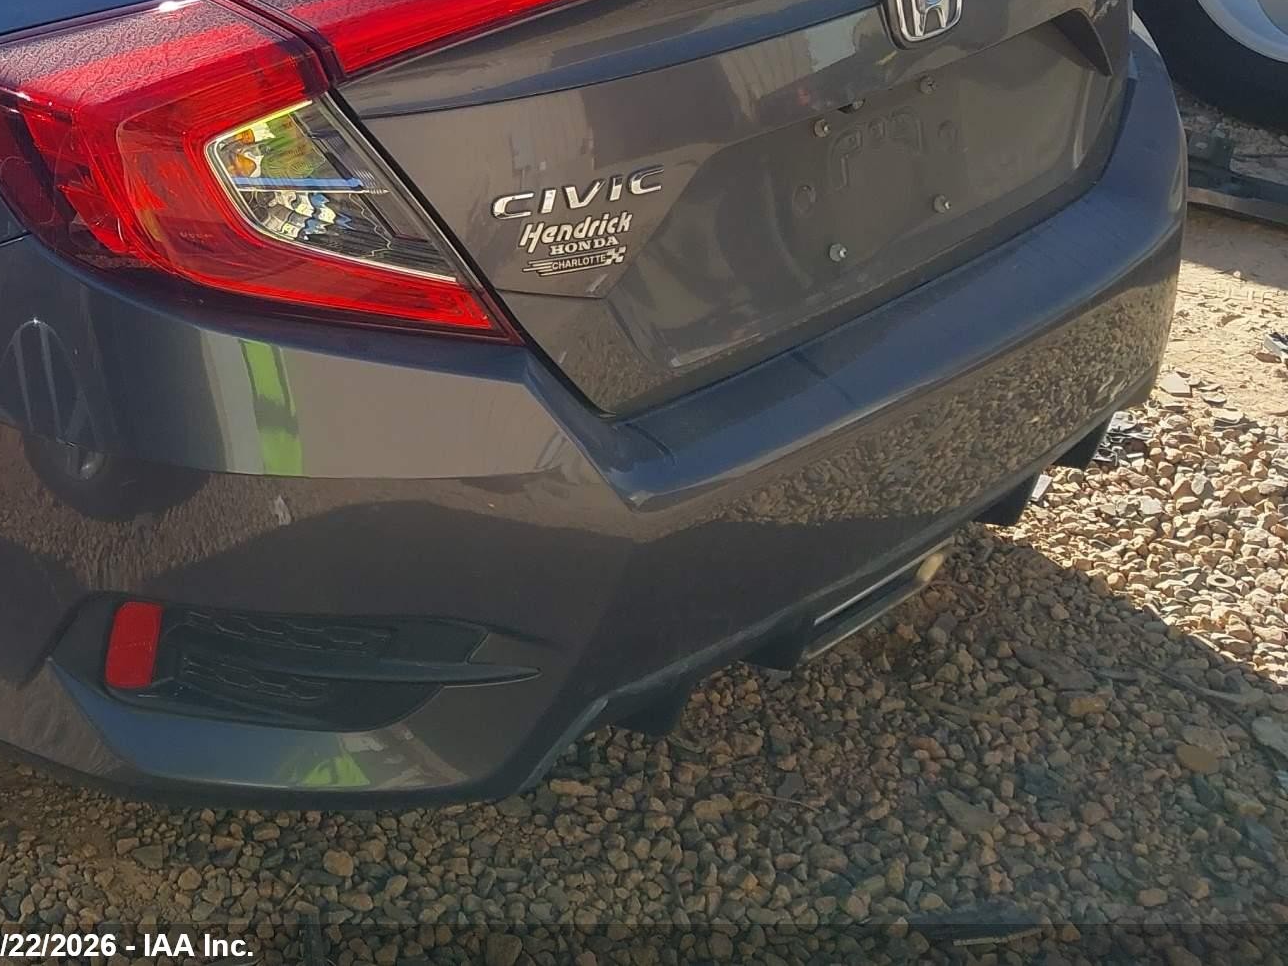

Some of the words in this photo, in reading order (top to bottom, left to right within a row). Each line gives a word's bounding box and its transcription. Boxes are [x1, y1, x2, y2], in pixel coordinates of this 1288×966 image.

[491, 165, 665, 220] CIVIC
[519, 211, 634, 254] Hendrick
[549, 235, 620, 256] HONDA
[550, 254, 607, 272] CHARLOTTE
